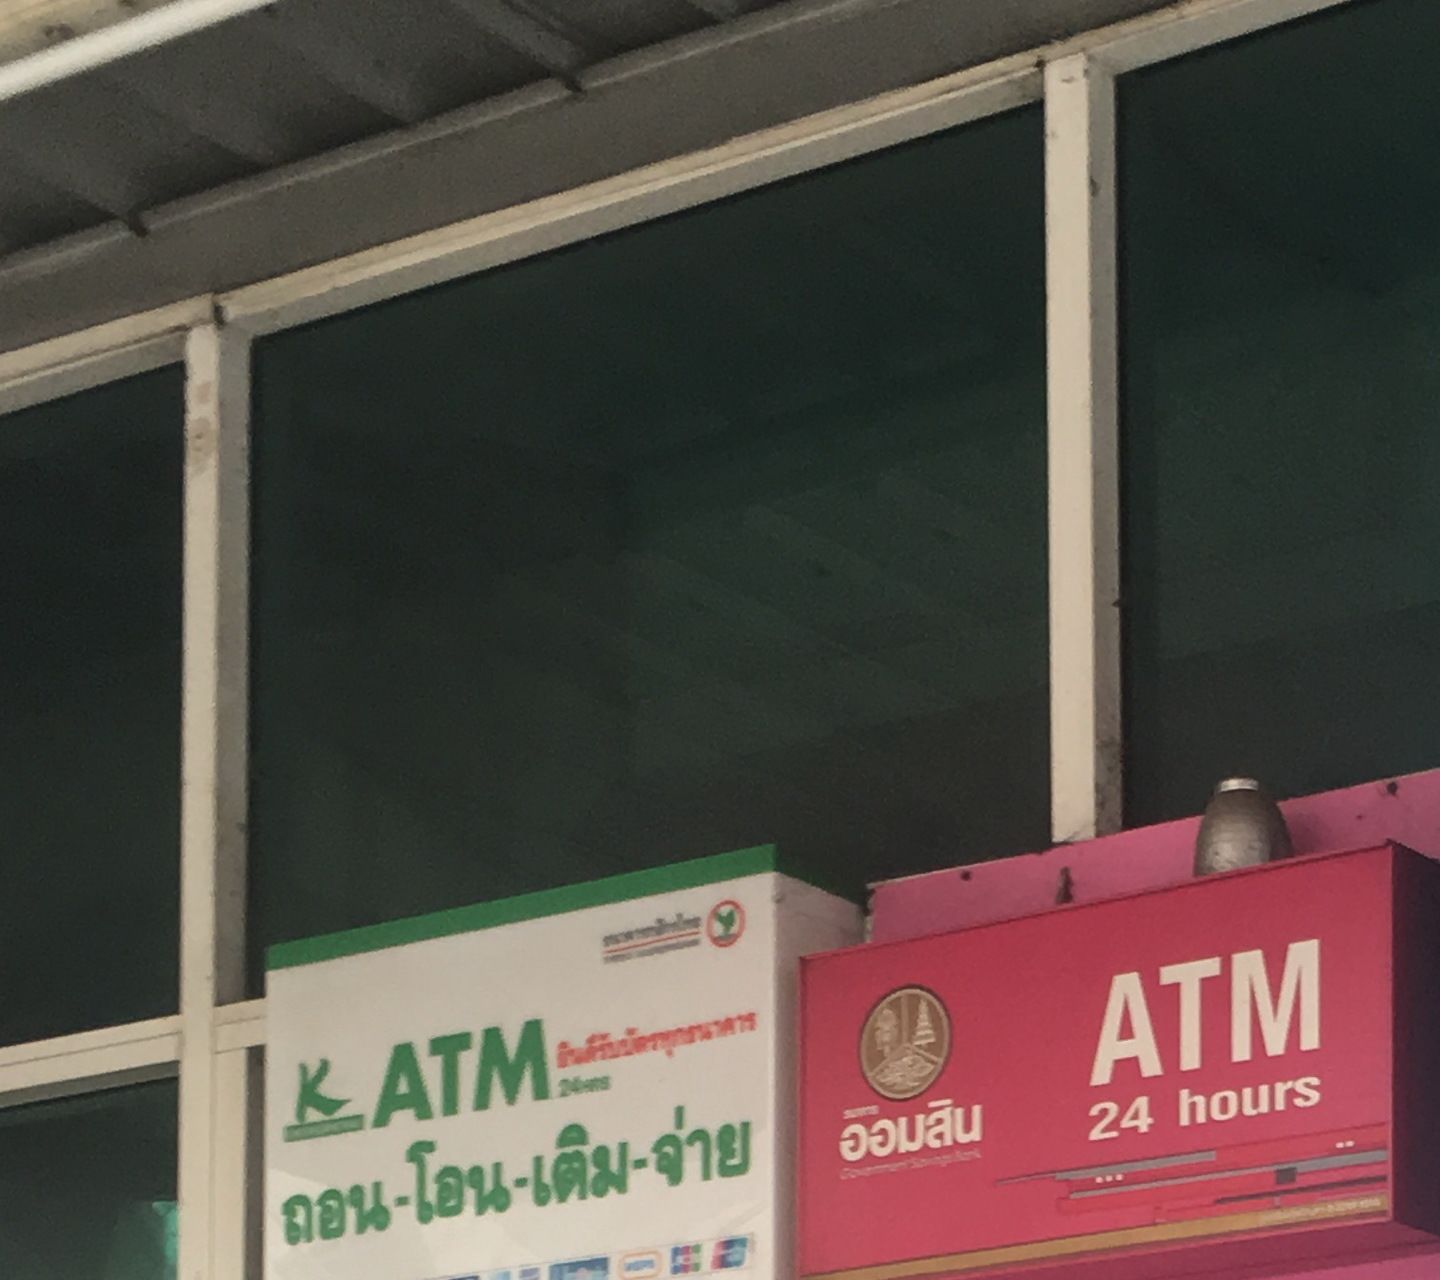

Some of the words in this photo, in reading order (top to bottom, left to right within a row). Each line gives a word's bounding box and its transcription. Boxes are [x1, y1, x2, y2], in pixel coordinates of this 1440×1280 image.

[1088, 938, 1321, 1087] ATM
[372, 1018, 551, 1128] ATM
[1088, 1096, 1154, 1141] 24
[1179, 1075, 1321, 1127] hours
[281, 1105, 752, 1245] ถอน-โอน-เติม-จ่าย
[839, 1099, 983, 1162] ออมสิน
